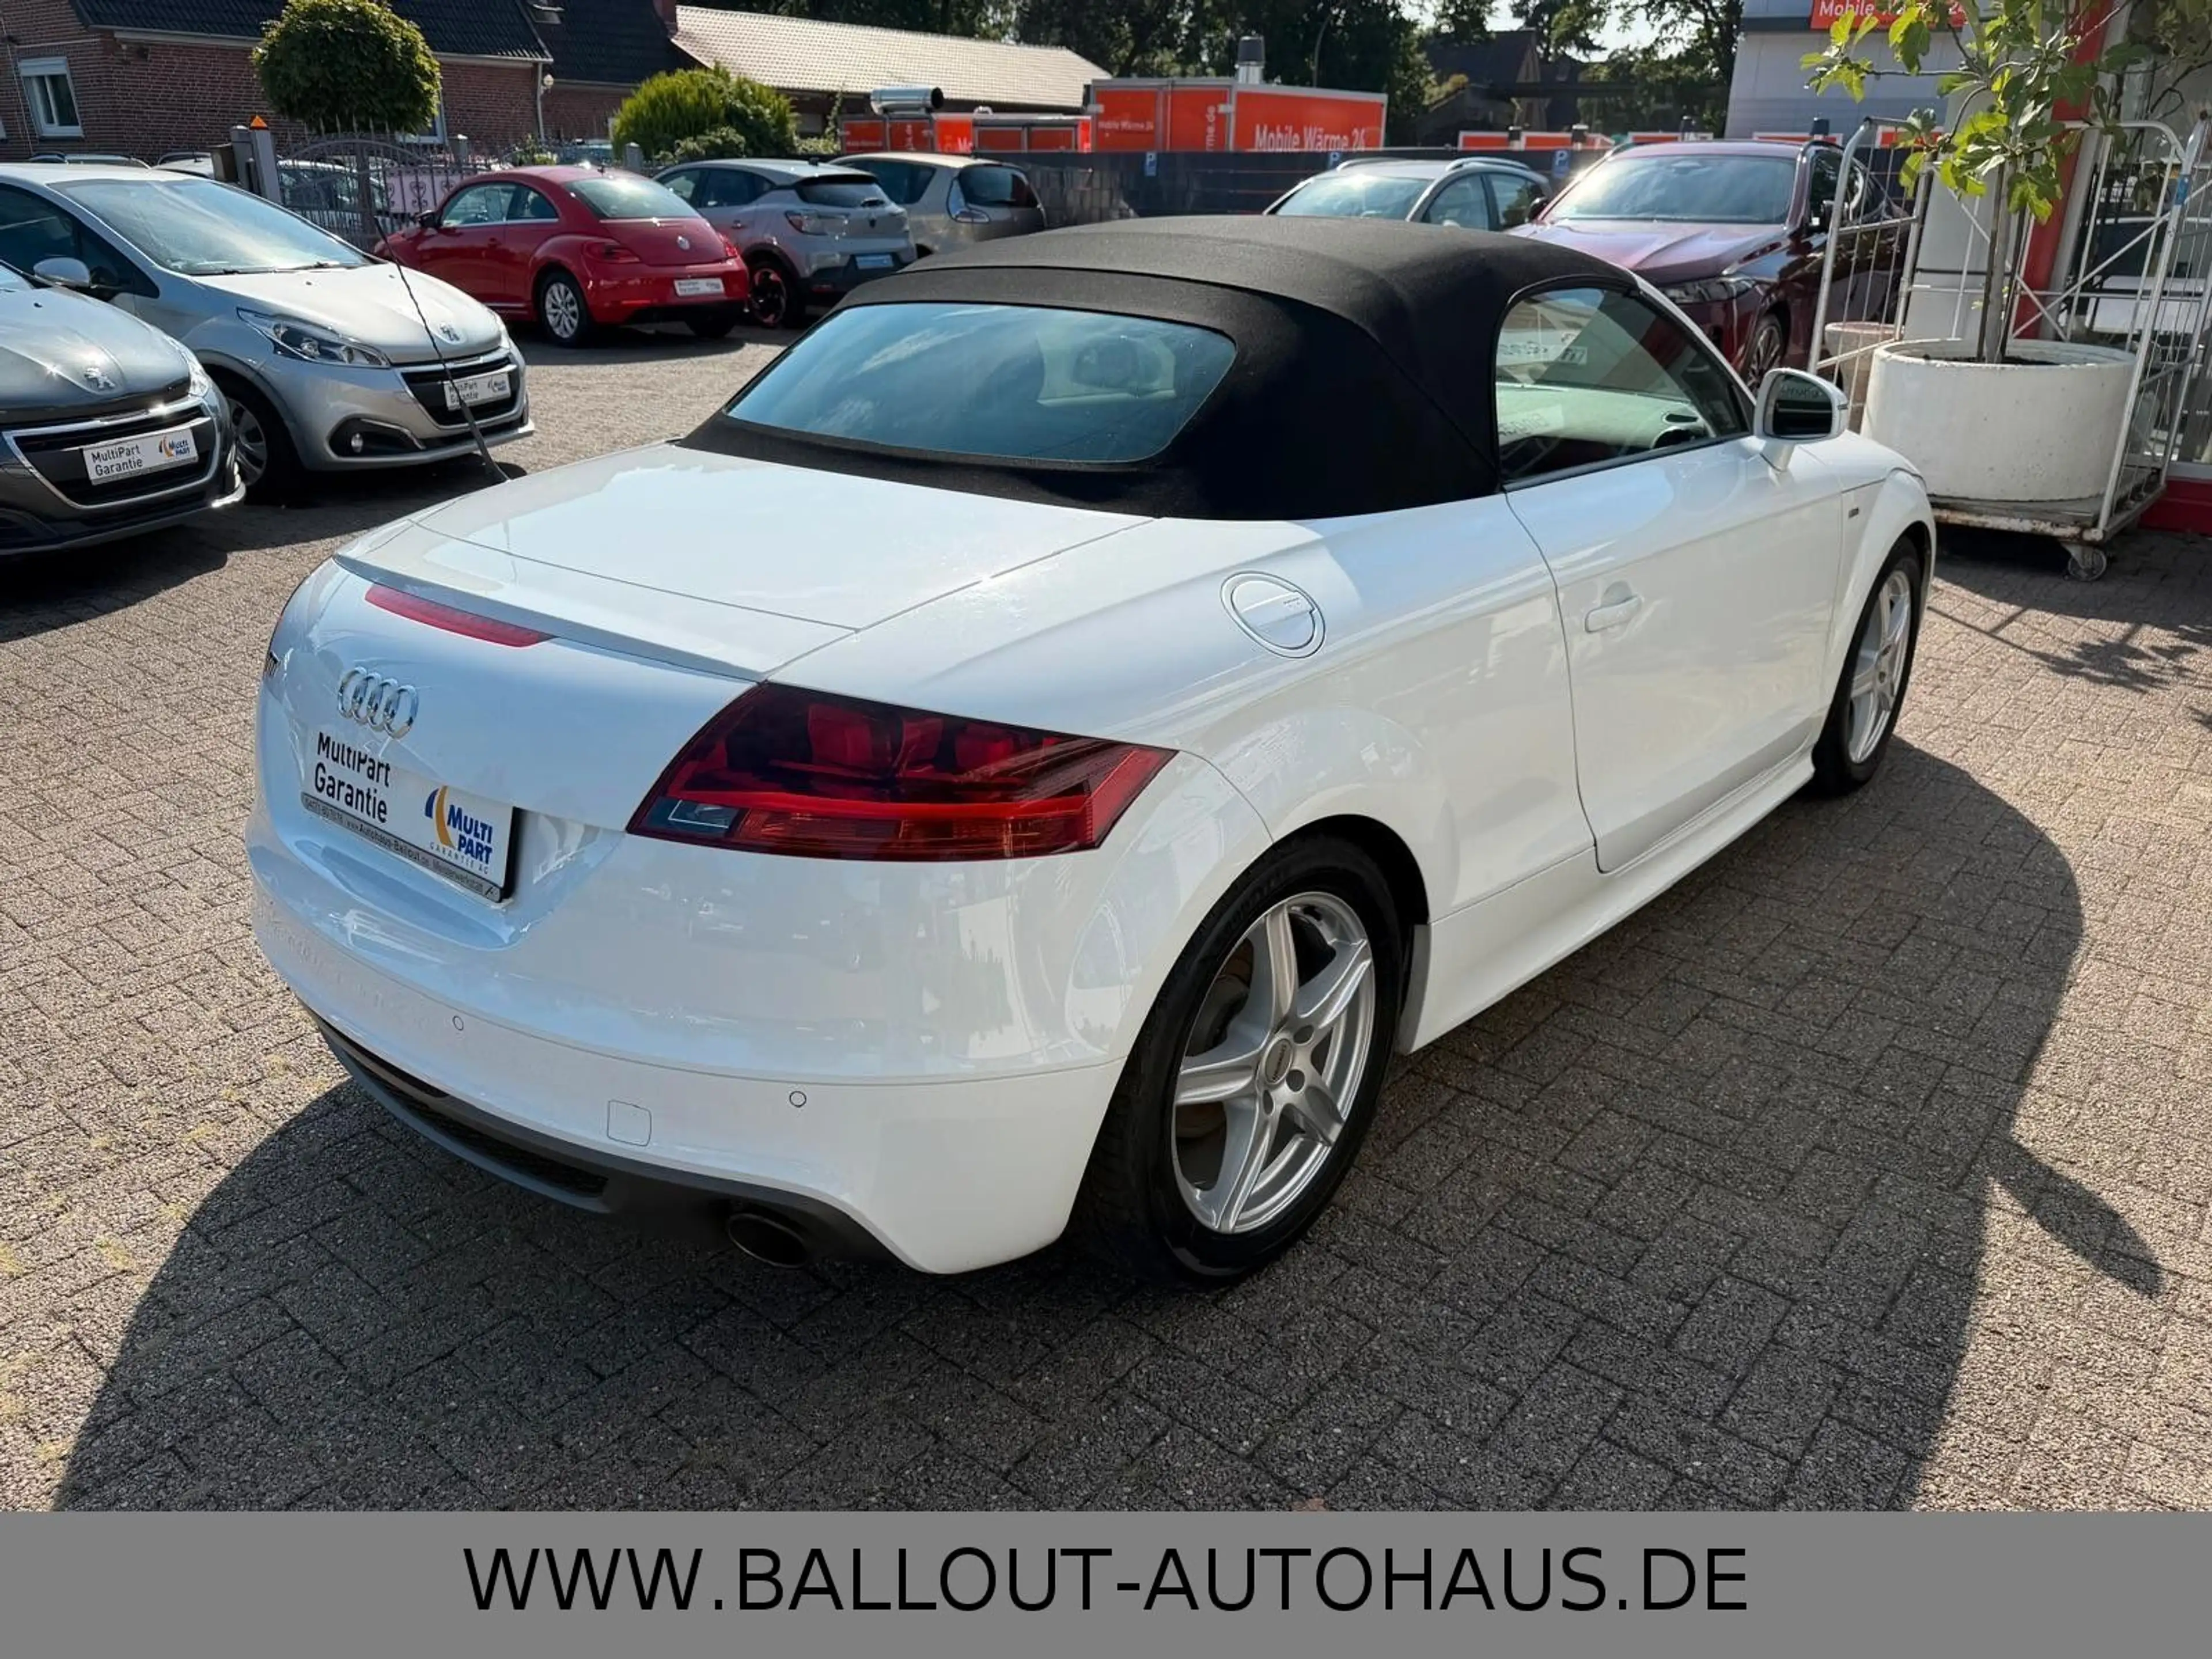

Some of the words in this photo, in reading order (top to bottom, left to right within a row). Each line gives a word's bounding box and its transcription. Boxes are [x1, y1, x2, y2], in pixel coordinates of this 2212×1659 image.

[1255, 124, 1300, 151] Mobile
[1304, 125, 1349, 151] Wärme
[91, 444, 141, 463] MultiPart
[96, 457, 143, 476] Garantie
[317, 731, 391, 787] MultiPart
[315, 762, 388, 823] Garantie
[447, 804, 493, 844] MULTI
[458, 834, 493, 865] PART
